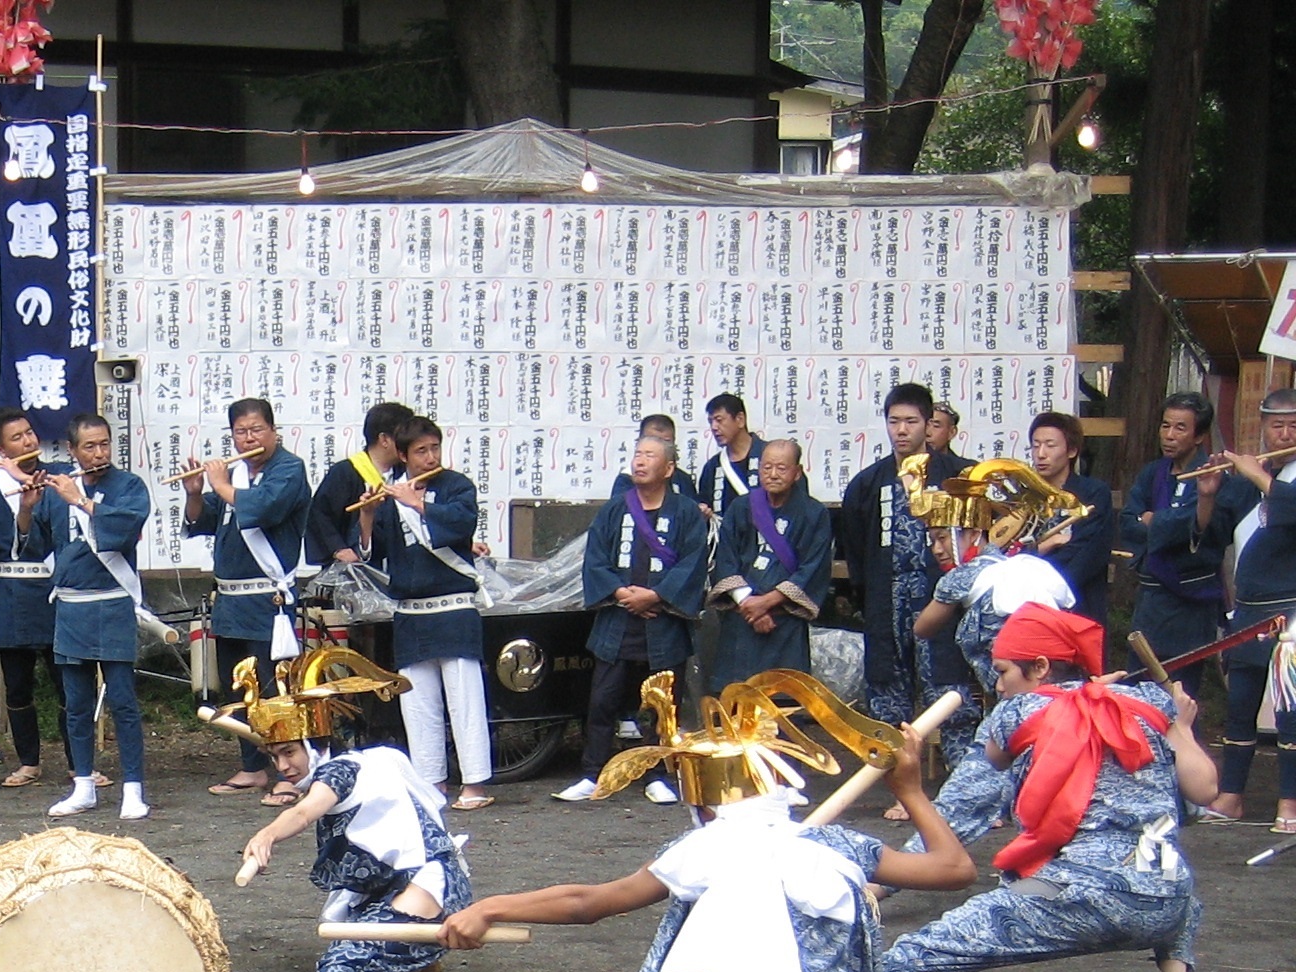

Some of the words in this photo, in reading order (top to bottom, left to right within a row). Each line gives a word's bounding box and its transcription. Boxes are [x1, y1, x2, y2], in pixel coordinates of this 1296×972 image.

[65, 114, 91, 349] 国指定重要無形民俗文化財
[113, 208, 124, 274] 一金五千円也
[266, 208, 278, 274] 一金五千円也
[1037, 209, 1050, 276] 一金五千円也
[116, 282, 128, 348] 一金五千円也
[168, 282, 180, 349] 一金五千円也
[220, 282, 232, 348] 一金五千円也
[272, 280, 283, 346] 一金五千円也
[370, 282, 382, 348] 一金五千円也
[422, 281, 434, 347] 一金五千円也
[575, 283, 588, 349] 一金五千円也
[627, 283, 639, 349] 一金五千円也
[678, 283, 690, 350] 一金五千円也
[780, 284, 792, 351] 一金五千円也
[832, 284, 844, 351] 一金五千円也
[882, 284, 895, 350] 一金五千円也
[934, 284, 946, 350] 一金五千円也
[986, 283, 998, 350] 一金五千円也
[1037, 283, 1050, 350] 一金五千円也
[170, 364, 182, 415] 上酒二升
[273, 364, 285, 414] 上酒二升
[427, 356, 438, 421] 一金五千円也
[478, 356, 490, 422] 一金五千円也
[530, 354, 542, 420] 一金五千円也
[580, 356, 592, 421] 一金五千円也
[682, 356, 694, 421] 一金五千円也
[786, 358, 798, 423] 一金五千円也
[837, 358, 849, 424] 一金五千円也
[991, 358, 1003, 424] 一金五千円也
[478, 428, 490, 493] 一金五千円也
[582, 438, 594, 489] 上酒二升
[169, 498, 182, 563] 一金五千円也
